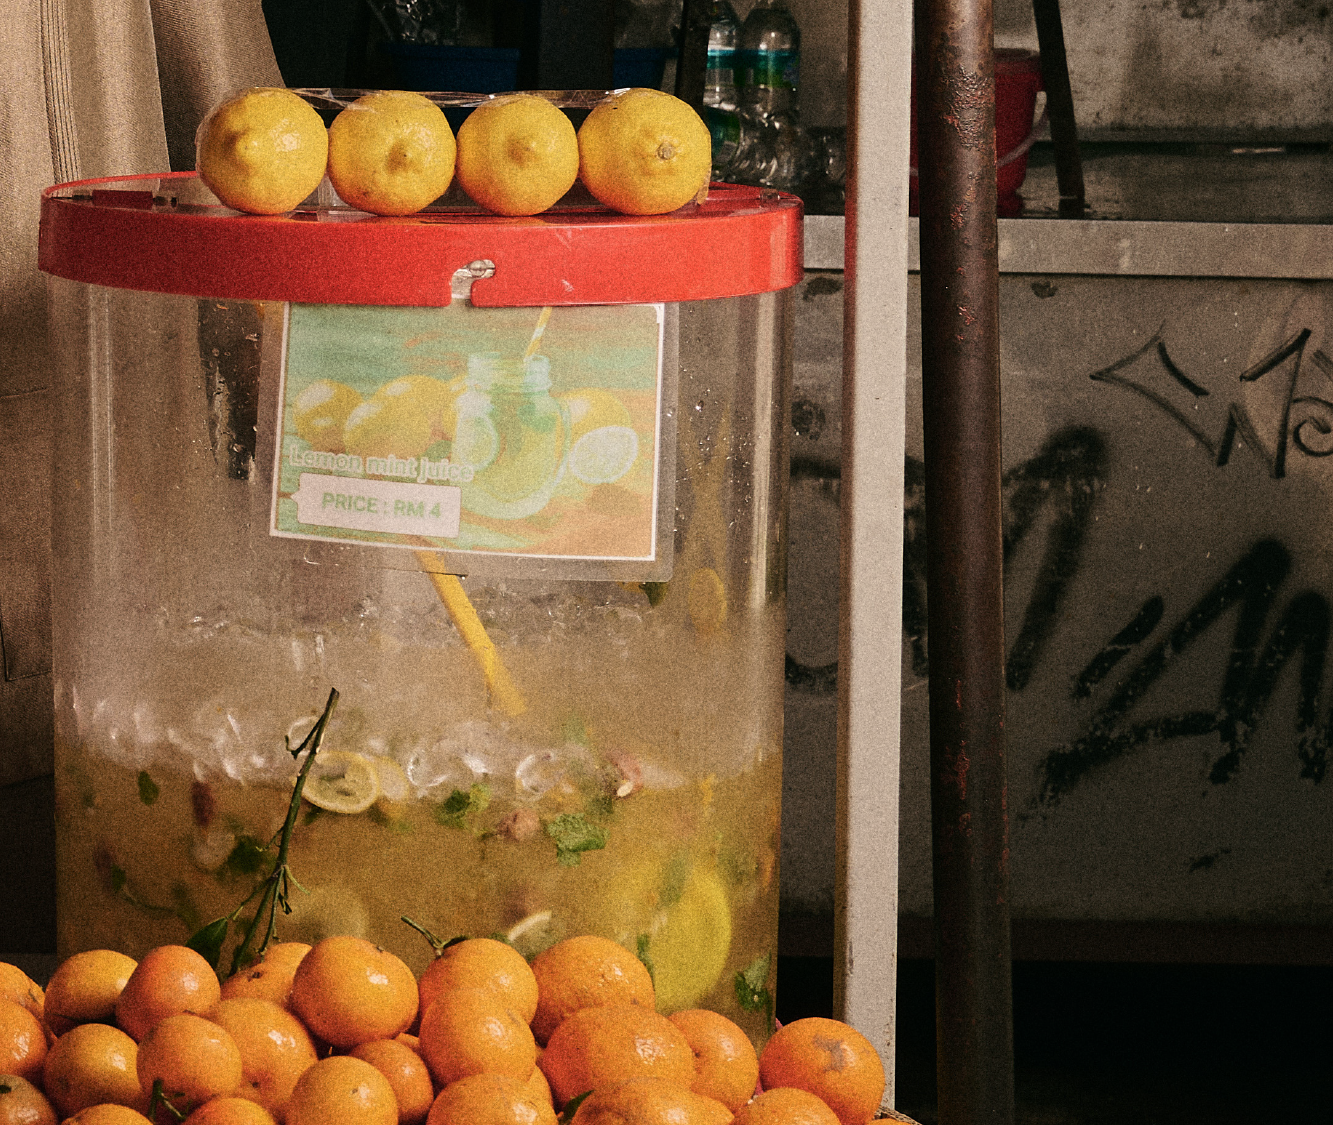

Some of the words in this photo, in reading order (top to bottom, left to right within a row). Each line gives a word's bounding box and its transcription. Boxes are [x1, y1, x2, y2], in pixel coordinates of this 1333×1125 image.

[290, 446, 363, 473] Lemon
[367, 455, 417, 478] mint
[321, 492, 378, 514] PRICE
[393, 499, 424, 518] RM
[429, 502, 441, 519] 4
